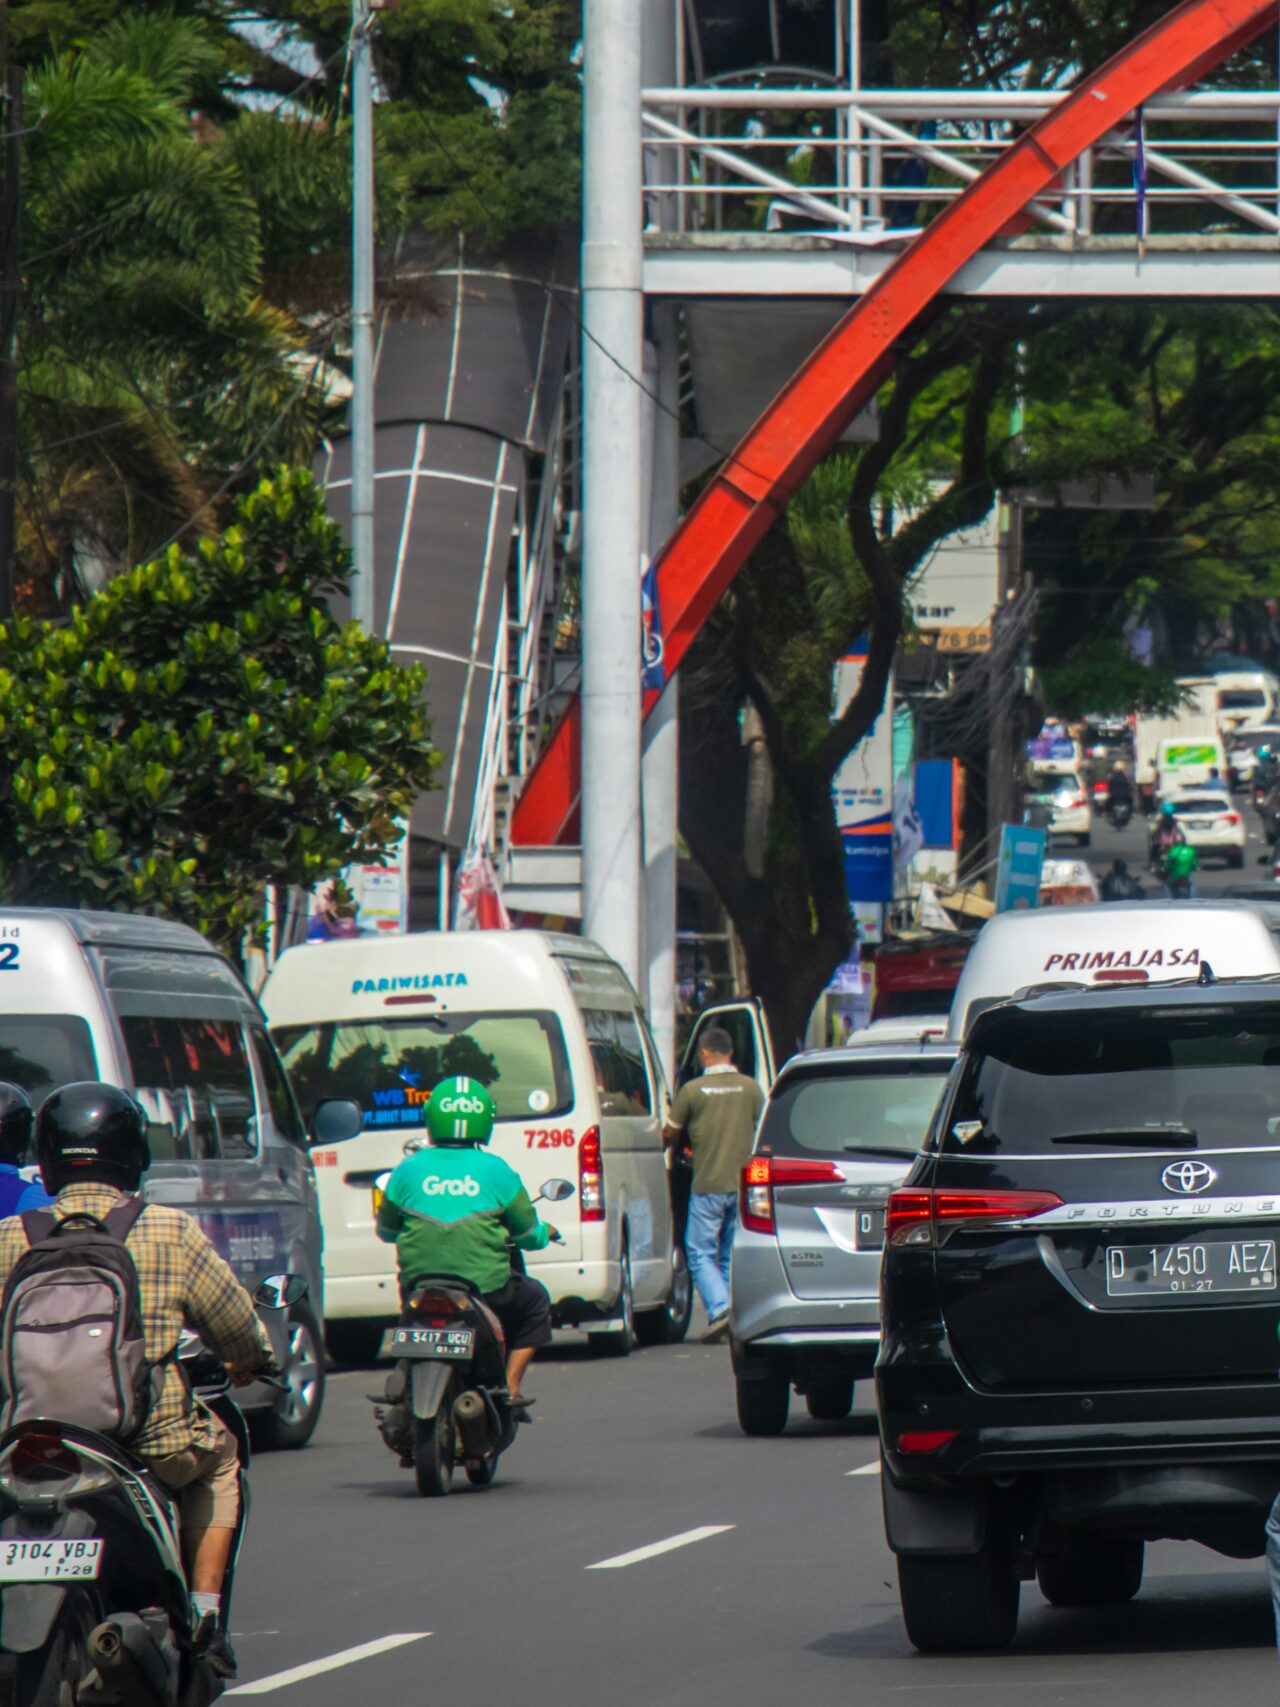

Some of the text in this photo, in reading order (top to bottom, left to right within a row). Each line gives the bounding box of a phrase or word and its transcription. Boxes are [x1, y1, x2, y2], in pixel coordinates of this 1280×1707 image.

[1043, 948, 1200, 971] PRIMAJASA
[352, 972, 468, 994] PARIWISATA
[371, 1088, 404, 1106] WB
[439, 1096, 485, 1114] Grab
[523, 1129, 575, 1149] 7296
[62, 1147, 98, 1155] HONDA
[422, 1175, 481, 1197] Grab
[861, 1213, 872, 1233] D
[1111, 1242, 1274, 1279] D 1450 AEZ
[411, 1331, 442, 1343] 5417
[447, 1333, 469, 1345] UCU
[6, 1542, 99, 1560] 3104 VBJ
[43, 1565, 94, 1576] 11-28
